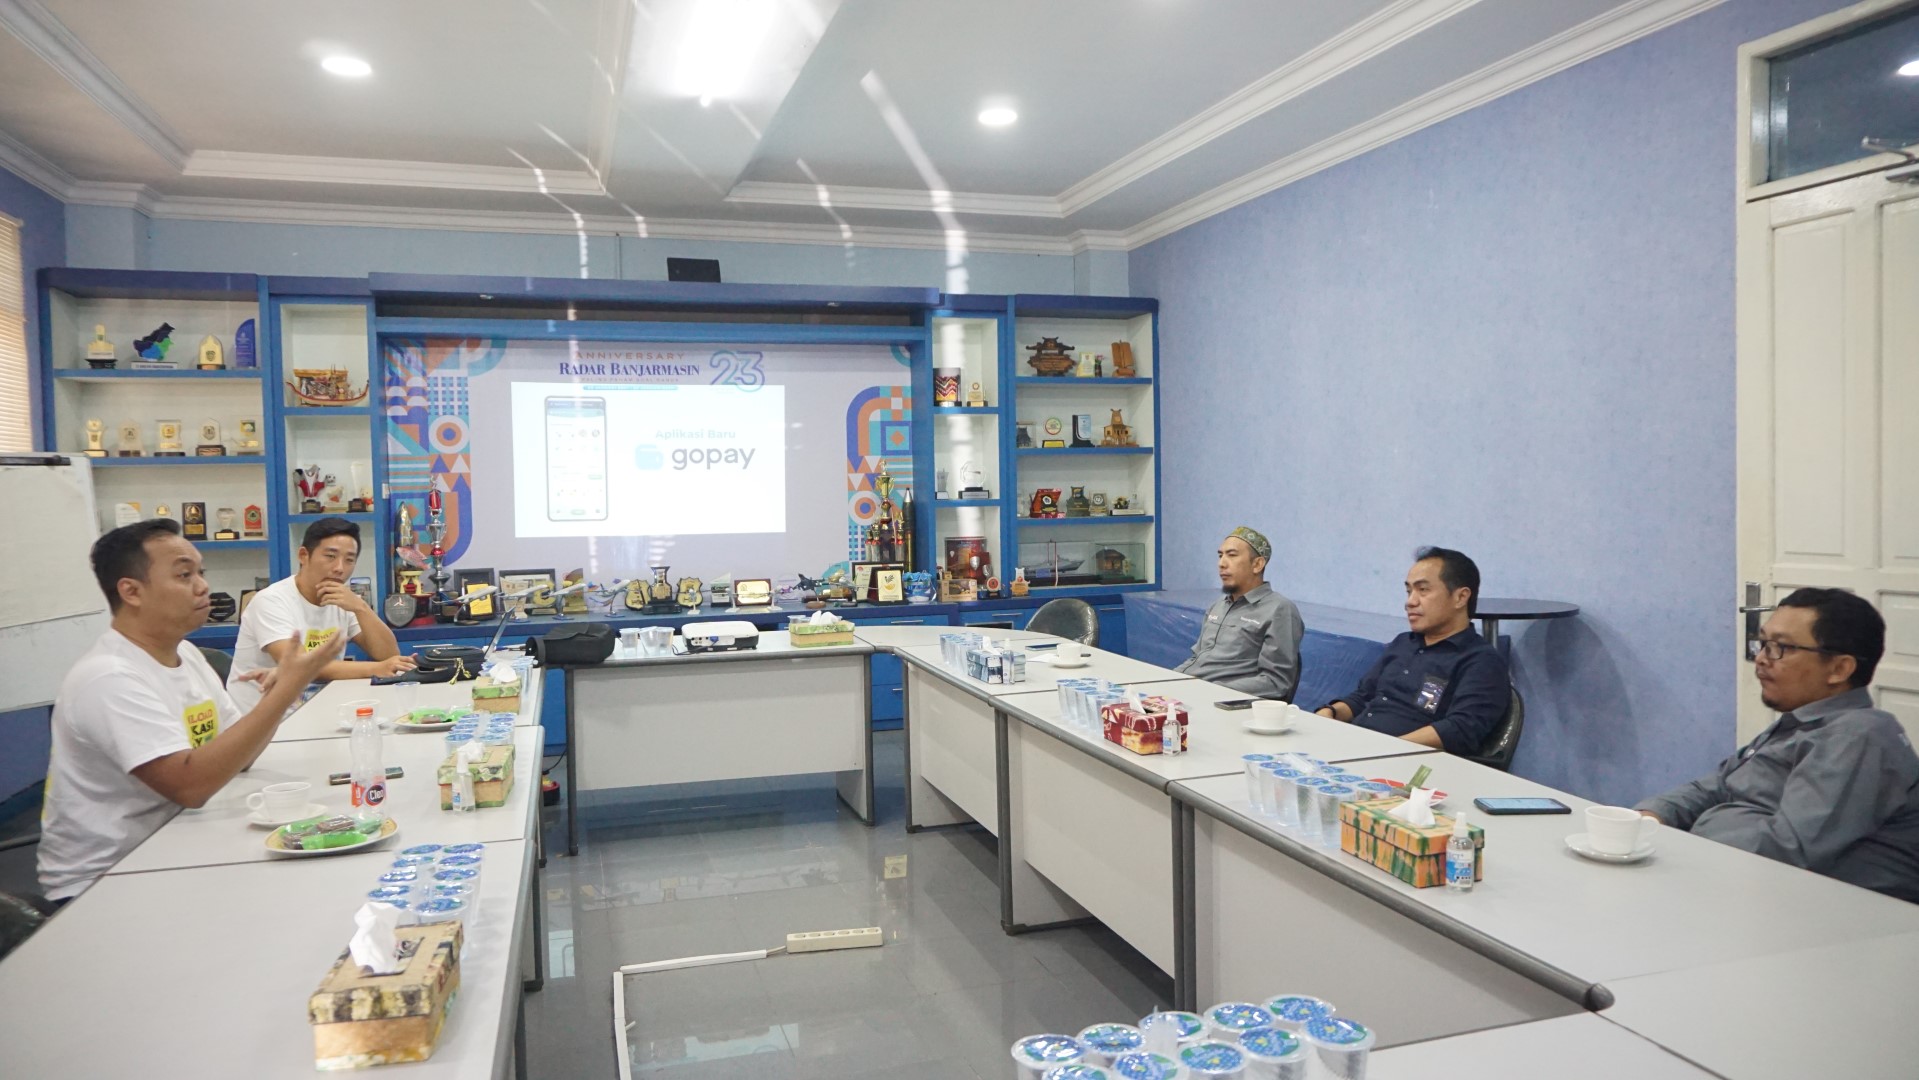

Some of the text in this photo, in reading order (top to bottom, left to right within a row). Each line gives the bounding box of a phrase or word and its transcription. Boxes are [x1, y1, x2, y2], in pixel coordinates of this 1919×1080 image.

[575, 351, 686, 361] ANNIVERSARY
[559, 362, 700, 377] RADAR BANJARMASIN
[709, 350, 766, 393] 23
[655, 428, 736, 440] Aplikasi Baru
[672, 448, 756, 471] gopay
